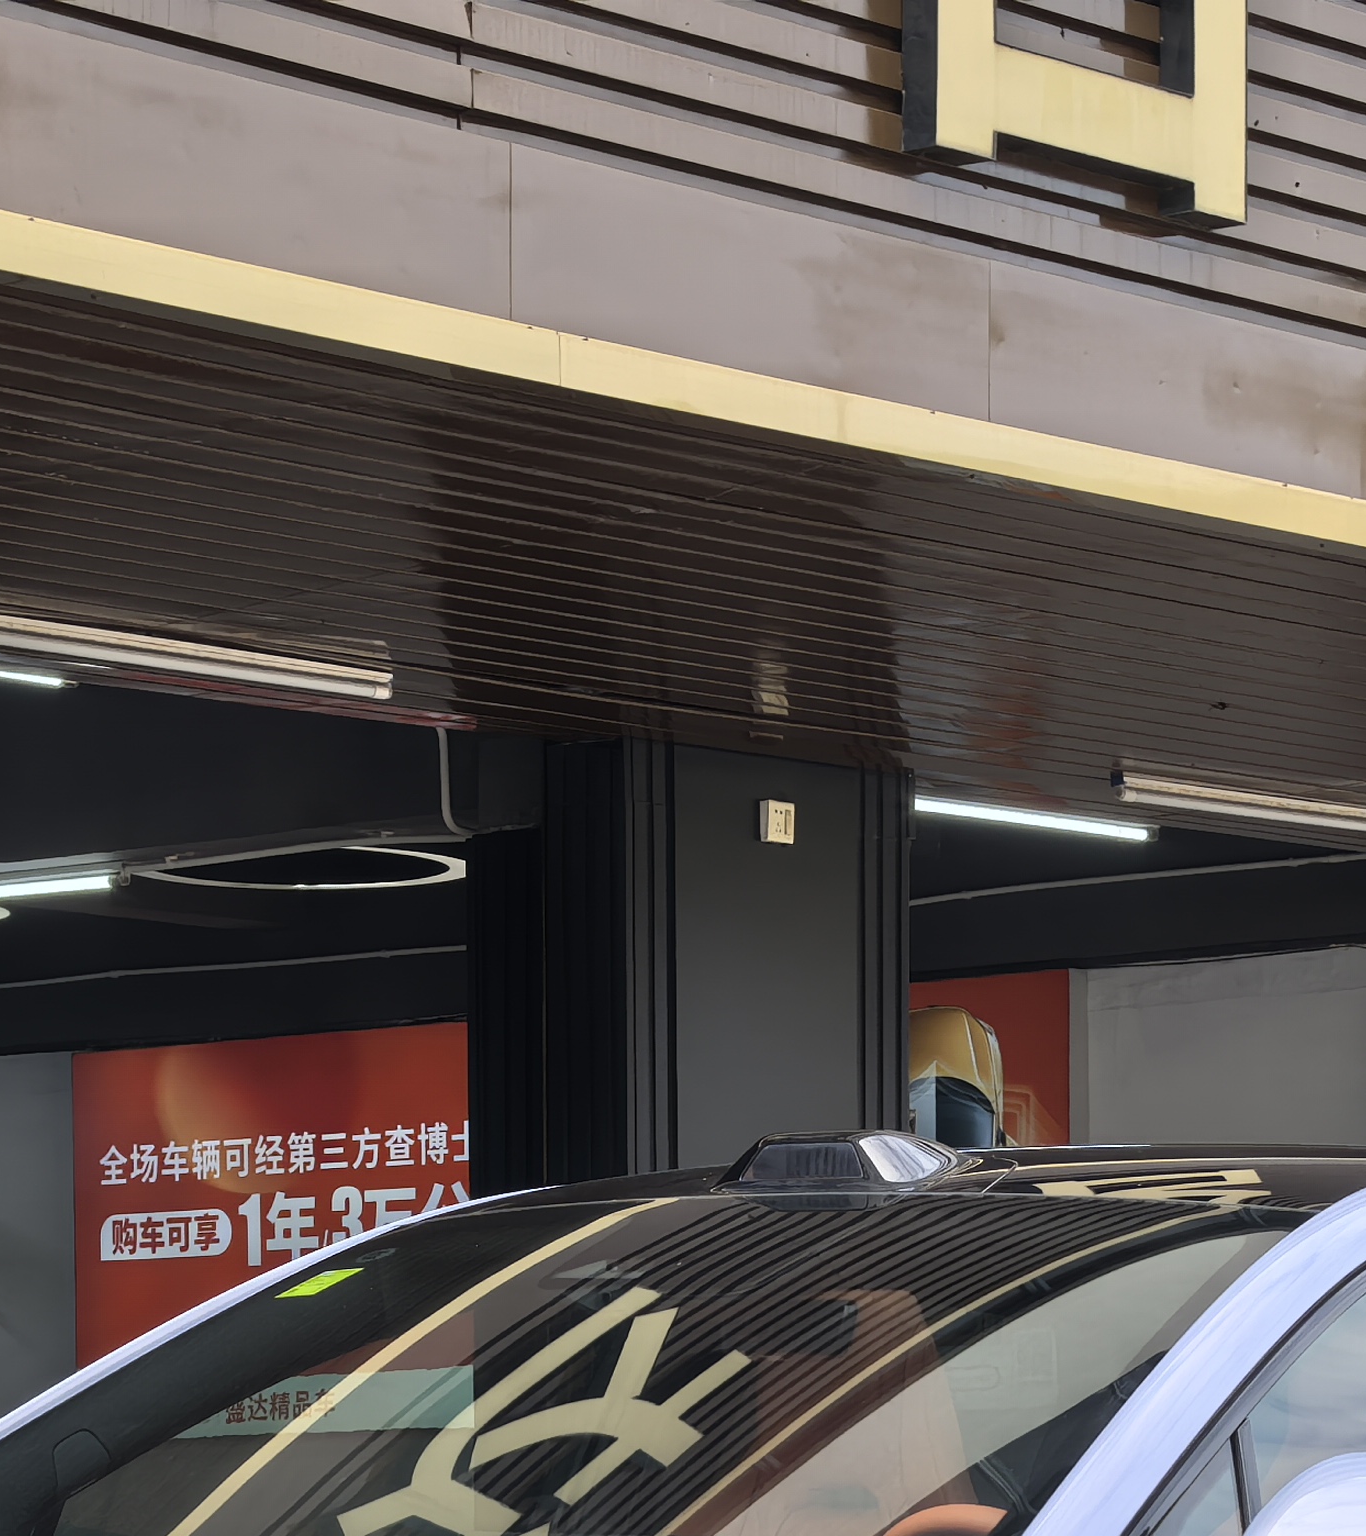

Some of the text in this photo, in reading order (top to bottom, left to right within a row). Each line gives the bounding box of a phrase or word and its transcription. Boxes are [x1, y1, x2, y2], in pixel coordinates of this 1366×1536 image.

[99, 1119, 469, 1187] 全场车辆可经第三方查博士
[111, 1212, 220, 1255] 购车可享
